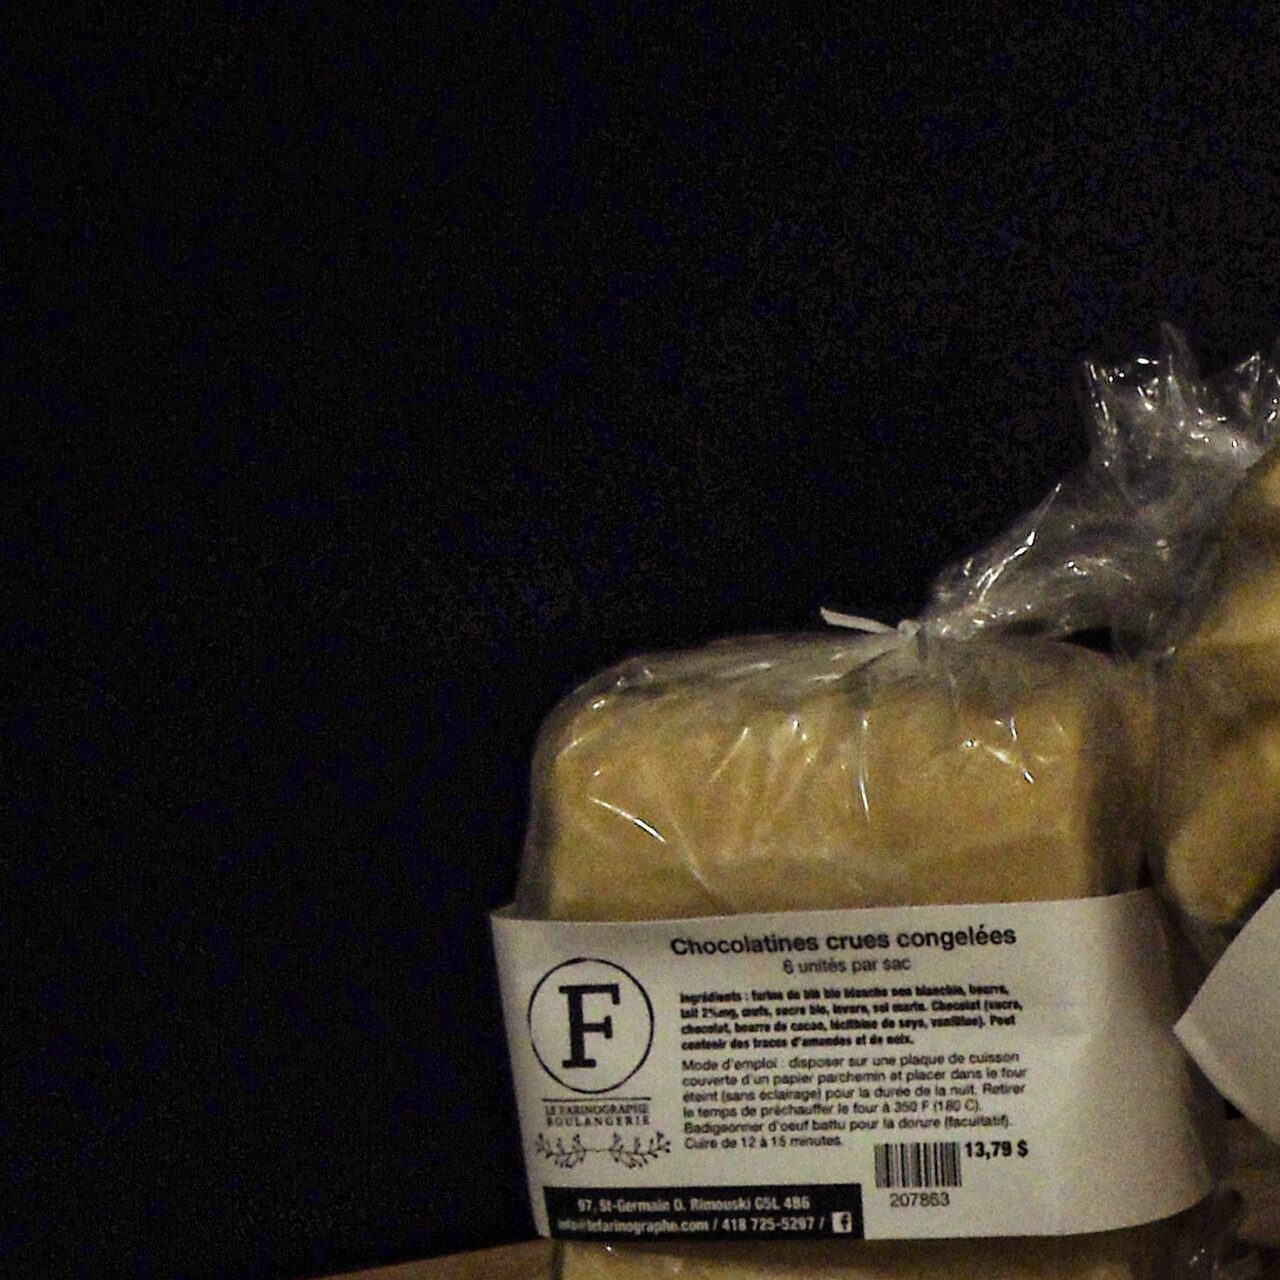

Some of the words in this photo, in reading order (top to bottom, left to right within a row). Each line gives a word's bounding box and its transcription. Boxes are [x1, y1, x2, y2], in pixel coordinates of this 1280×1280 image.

[671, 934, 819, 955] Chocolatines
[826, 933, 889, 950] crues
[897, 924, 1016, 950] congelées
[783, 959, 794, 974] 6
[799, 958, 846, 973] unités
[853, 959, 877, 975] par
[883, 958, 911, 971] sac
[559, 983, 621, 1069] F
[682, 1059, 718, 1071] Mode
[789, 1058, 843, 1070] disposer
[849, 1058, 867, 1067] sur
[873, 1057, 896, 1066] une
[900, 1054, 944, 1068] plaque
[948, 1053, 964, 1064] de
[969, 1052, 1019, 1064] cuisson
[683, 1075, 737, 1086] couverte
[773, 1073, 812, 1086] papier
[818, 1072, 885, 1085] parchemin
[906, 1069, 945, 1082] placer
[951, 1068, 982, 1079] dans
[987, 1068, 997, 1078] le
[1002, 1067, 1027, 1078] four
[825, 1088, 855, 1101] pour
[859, 1088, 870, 1097] la
[874, 1086, 910, 1097] durée
[915, 1086, 931, 1096] de
[936, 1086, 946, 1096] la
[982, 1083, 1025, 1095] Retirer
[683, 1107, 694, 1118] le
[698, 1106, 737, 1119] temps
[741, 1105, 756, 1116] de
[838, 1103, 848, 1114] le
[853, 1102, 878, 1113] four
[922, 1100, 928, 1111] F
[547, 1116, 650, 1126] BOULANGERIE
[812, 1119, 845, 1131] battu
[850, 1119, 879, 1132] pour
[883, 1118, 894, 1129] la
[685, 1138, 717, 1150] Cuire
[721, 1138, 737, 1149] de
[742, 1137, 755, 1148] 12
[772, 1136, 786, 1147] 15
[965, 1141, 1012, 1160] 13,79
[1017, 1139, 1029, 1158] $
[600, 1199, 669, 1212] St-Germain
[691, 1197, 749, 1211] Rimouski
[890, 1192, 950, 1207] 207863
[722, 1218, 747, 1231] 418
